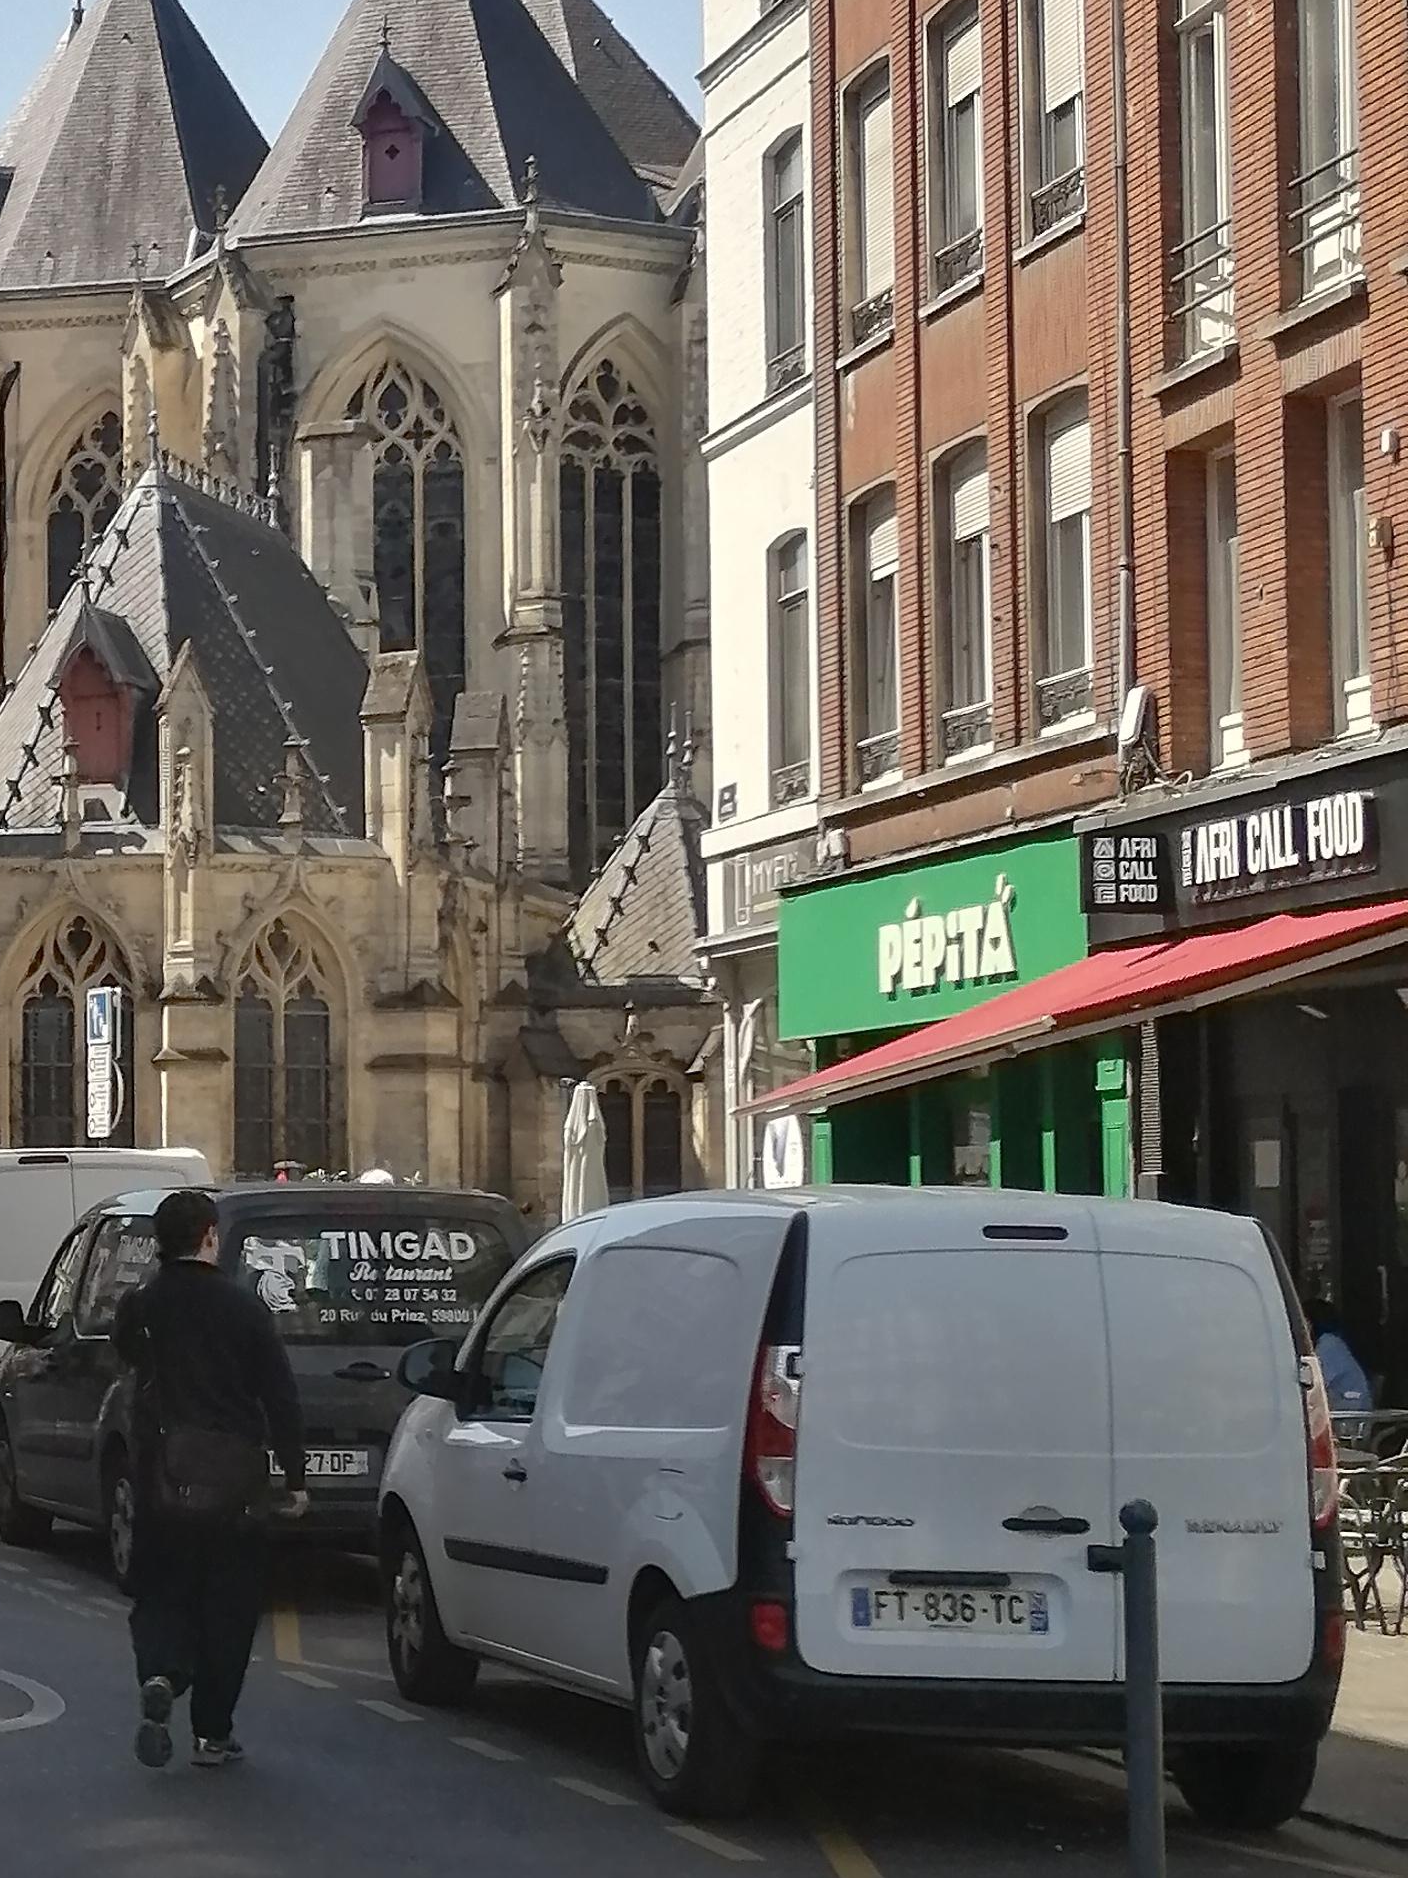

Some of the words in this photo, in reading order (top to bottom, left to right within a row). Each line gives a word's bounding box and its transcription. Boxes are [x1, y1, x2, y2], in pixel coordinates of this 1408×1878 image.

[1119, 837, 1157, 859] AFRI
[1195, 819, 1240, 884] AFRI
[1246, 805, 1299, 875] CALL
[1306, 792, 1364, 862] FOOD
[1119, 860, 1158, 881] CALL
[1119, 883, 1158, 903] FOOD
[320, 1231, 476, 1261] TIMGAD
[349, 1261, 453, 1281] Retaurant
[339, 1309, 364, 1322] Ru
[873, 1590, 1026, 1626] FT-836-TC
